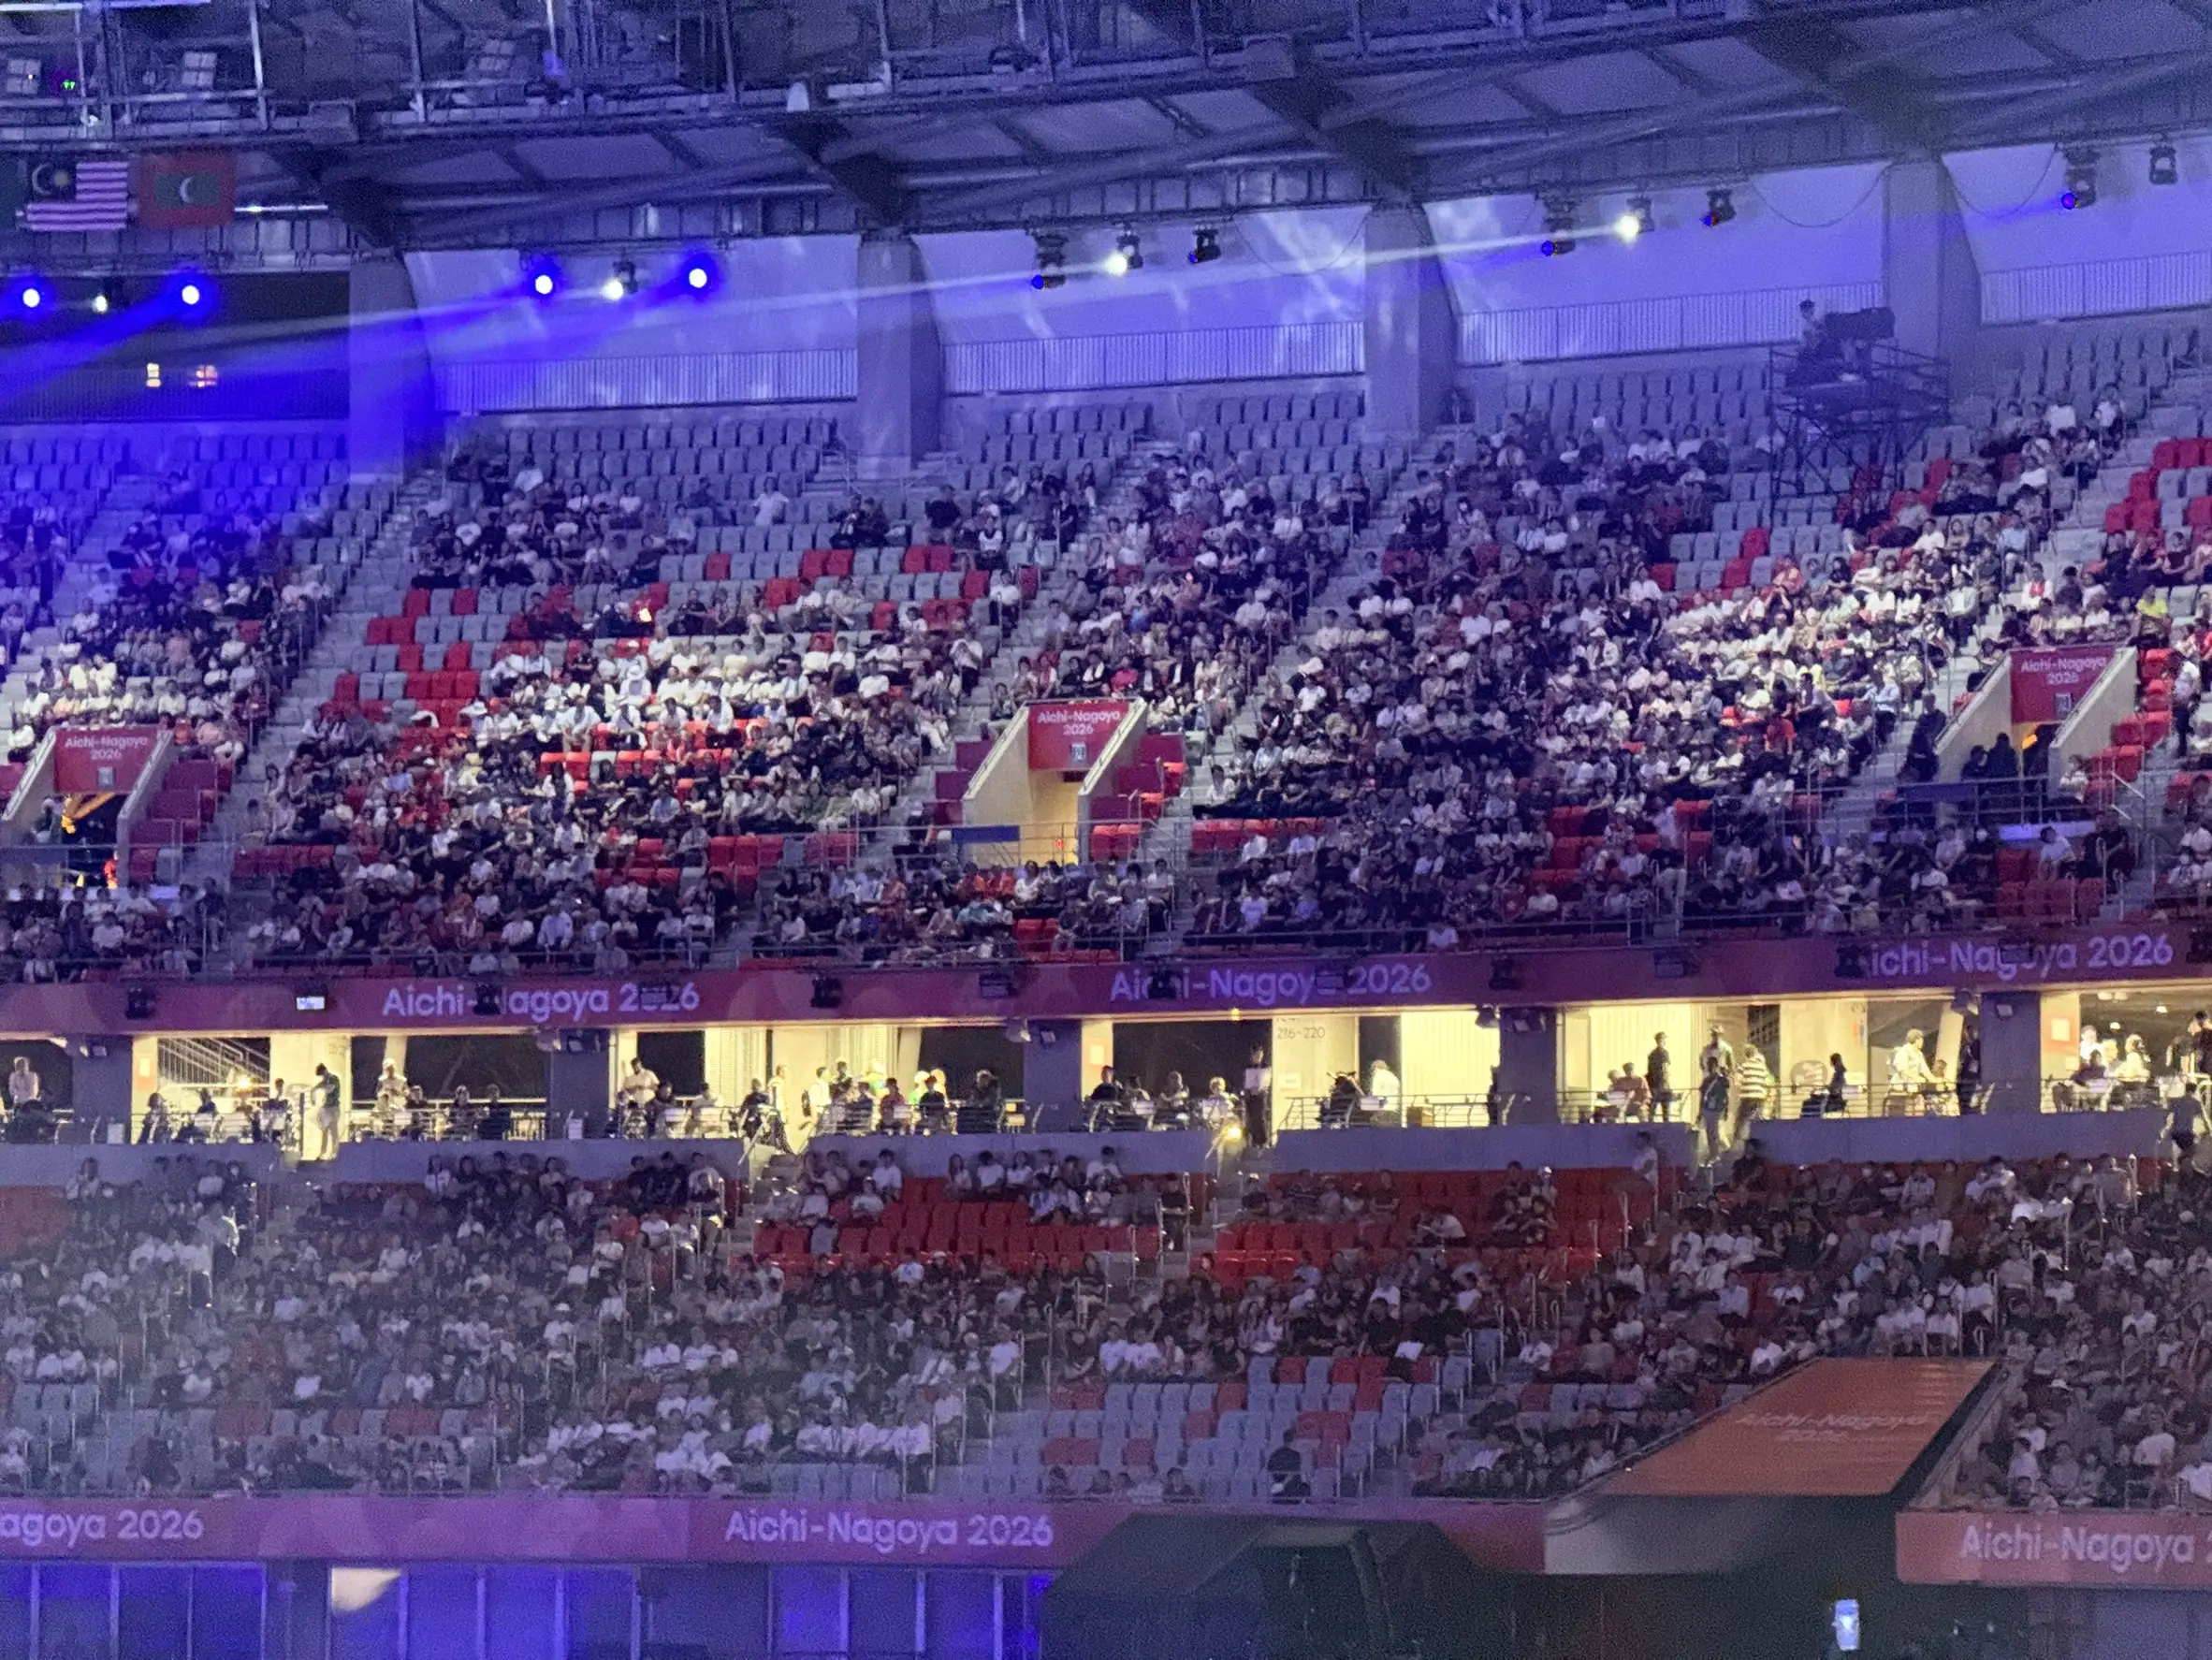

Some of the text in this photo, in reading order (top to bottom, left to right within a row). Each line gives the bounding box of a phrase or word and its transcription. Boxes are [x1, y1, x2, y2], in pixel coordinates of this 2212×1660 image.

[1037, 710, 1121, 724] Aichi-Nagoya
[2088, 935, 2174, 968] 2026
[1347, 963, 1432, 995] 2026
[382, 984, 609, 1023] Aichi-agoya
[0, 1508, 204, 1549] agoya 2026
[724, 1507, 1054, 1554] Aichi-Nagoya 2026
[1959, 1521, 2195, 1575] Aichi-Nagoya
